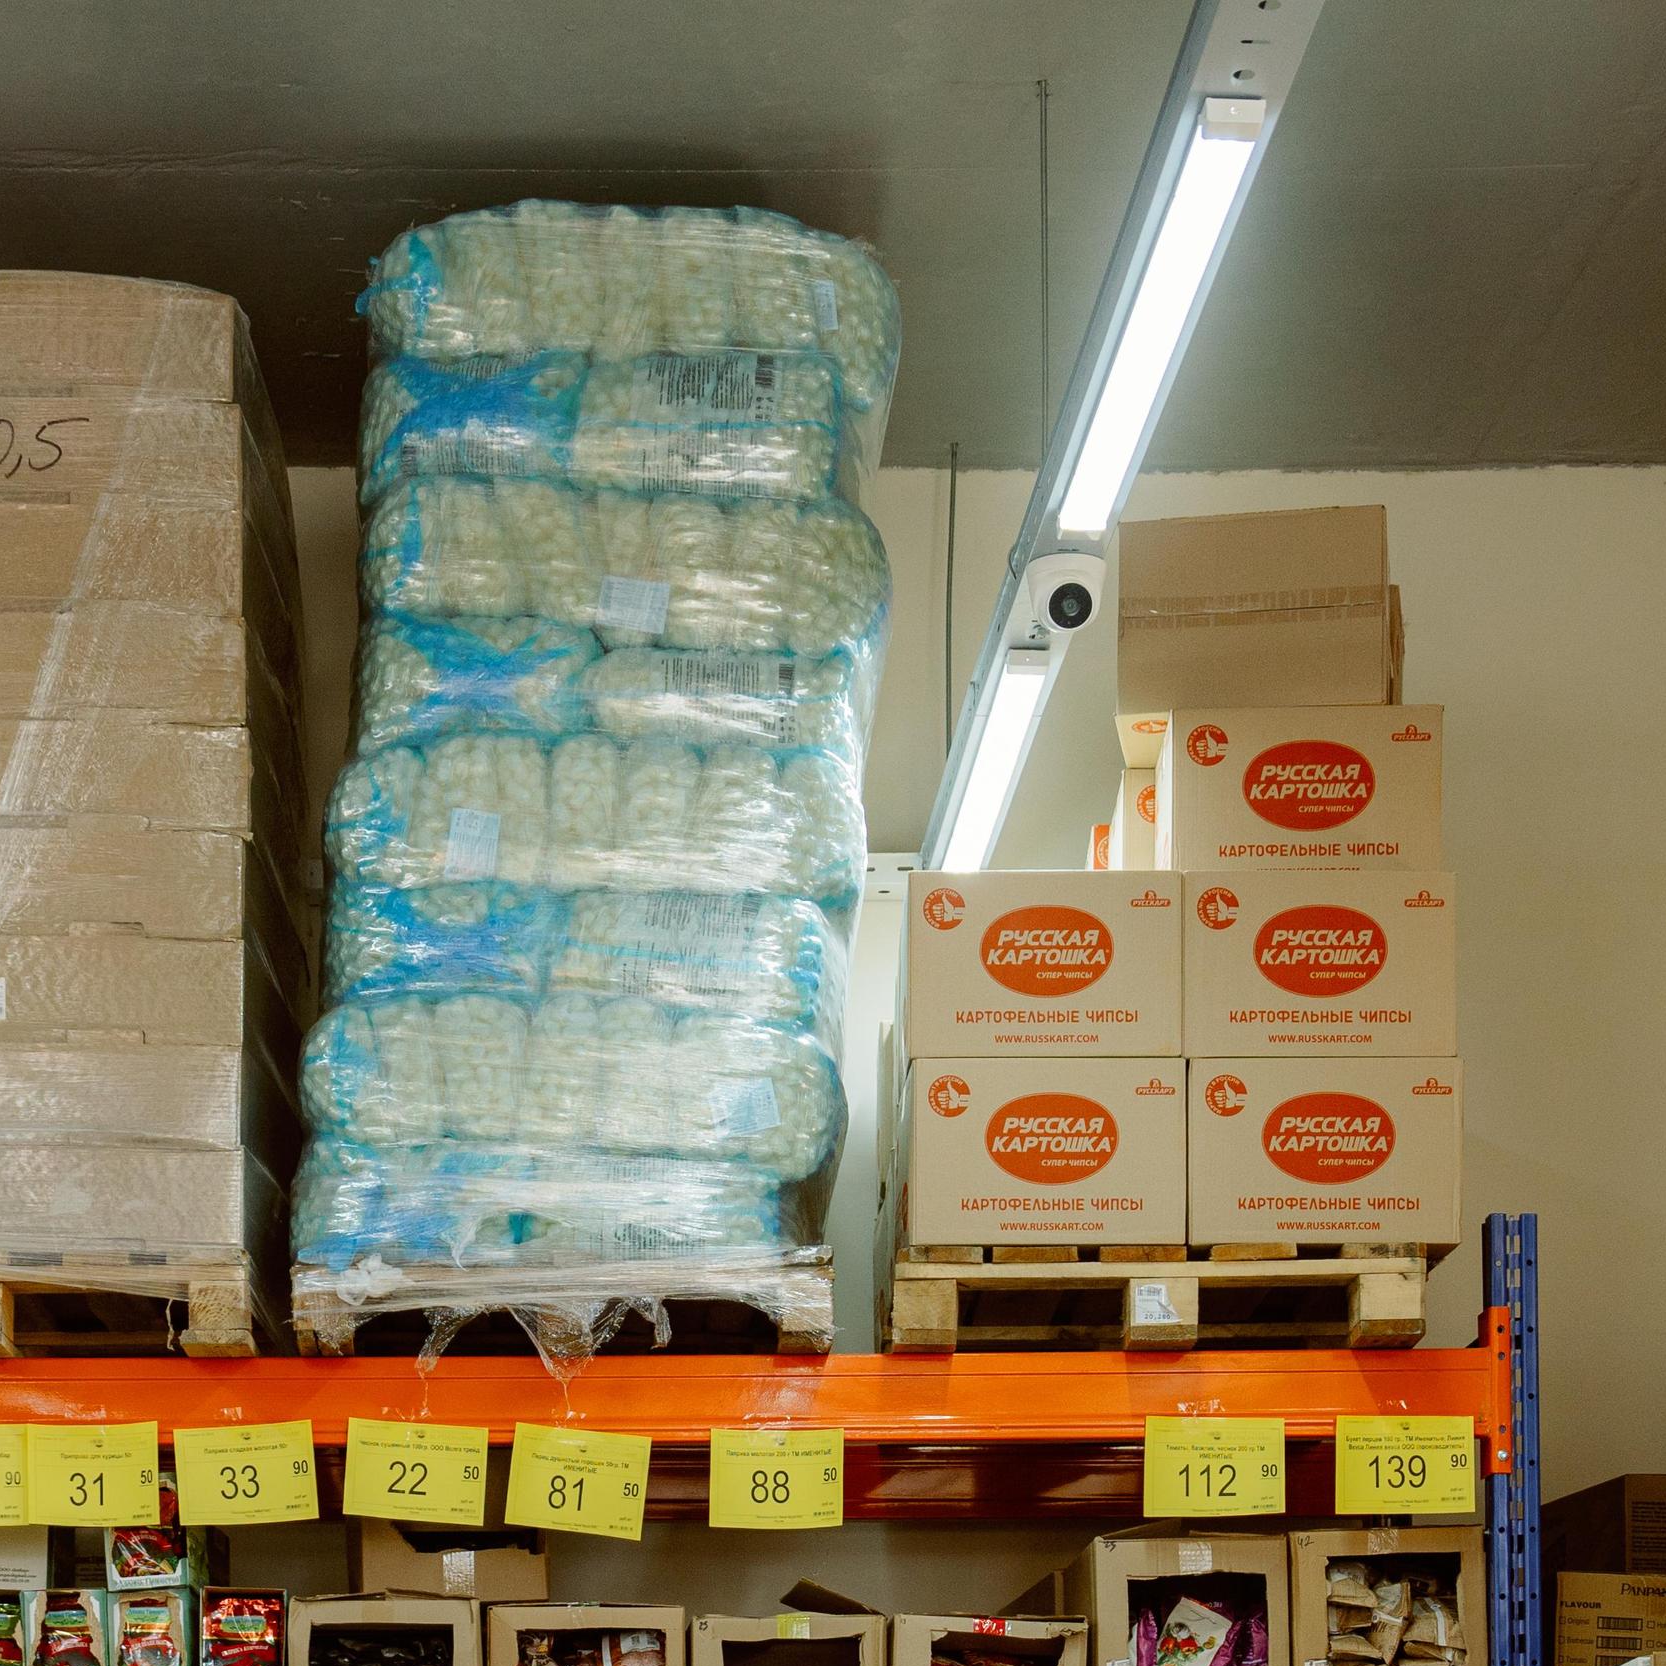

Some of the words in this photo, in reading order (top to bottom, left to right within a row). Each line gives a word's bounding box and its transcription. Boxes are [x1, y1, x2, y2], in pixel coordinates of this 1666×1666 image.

[1259, 762, 1361, 781] РУССКАЯ
[1248, 780, 1368, 800] КАРТОШКА
[1298, 804, 1324, 814] СУПЕР
[1326, 804, 1355, 813] ЧИПСЫ
[1217, 843, 1341, 859] КАРТОФЕЛЬНЫЕ
[1347, 843, 1400, 858] ЧИПСЫ
[997, 928, 1100, 947] РУССКАЯ
[1271, 928, 1373, 947] РУССКАЯ
[987, 947, 1106, 966] КАРТОШКА
[1260, 947, 1380, 966] КАРТОШКА
[1036, 971, 1062, 980] СУПЕР
[1064, 971, 1093, 980] ЧИПСЫ
[1310, 971, 1336, 980] СУПЕР
[1338, 971, 1367, 980] ЧИПСЫ
[956, 1009, 1080, 1025] КАРТОФЕЛЬНЫЕ
[1086, 1009, 1138, 1024] ЧИПСЫ
[1229, 1009, 1354, 1025] КАРТОФЕЛЬНЫЕ
[1359, 1009, 1412, 1024] ЧИПСЫ
[994, 1033, 1100, 1044] WWW.RUSSKART.COM
[1268, 1033, 1373, 1044] WWW.RUSSKART.COM
[1003, 1116, 1105, 1135] РУССКАЯ
[1279, 1115, 1381, 1134] РУССКАЯ
[992, 1134, 1111, 1153] КАРТОШКА
[1268, 1134, 1388, 1153] КАРТОШКА
[1041, 1158, 1067, 1168] СУПЕР
[1069, 1158, 1098, 1167] ЧИПСЫ
[1318, 1158, 1344, 1167] СУПЕР
[1346, 1158, 1375, 1167] ЧИПСЫ
[961, 1197, 1085, 1213] КАРТОФЕЛЬНЫЕ
[1091, 1197, 1144, 1212] ЧИПСЫ
[1237, 1196, 1362, 1213] КАРТОФЕЛЬНЫЕ
[1367, 1196, 1420, 1211] ЧИПСЫ
[999, 1220, 1105, 1232] WWW.RUSSKART.COM
[1276, 1220, 1381, 1231] WWW.RUSSKART.COM
[5, 1471, 21, 1486] 90
[220, 1465, 260, 1500] 33
[293, 1459, 309, 1475] 90
[387, 1461, 428, 1496] 22
[463, 1466, 480, 1480] 50
[1369, 1455, 1427, 1488] 139
[1450, 1453, 1467, 1468] 90
[69, 1472, 104, 1506] 31
[140, 1469, 153, 1485] 50
[751, 1470, 790, 1504] 88
[823, 1467, 837, 1482] 50
[1179, 1464, 1237, 1497] 112
[1261, 1464, 1278, 1478] 90
[548, 1475, 585, 1511] 81
[623, 1482, 639, 1497] 50
[1560, 1601, 1602, 1609] FLAVOUR
